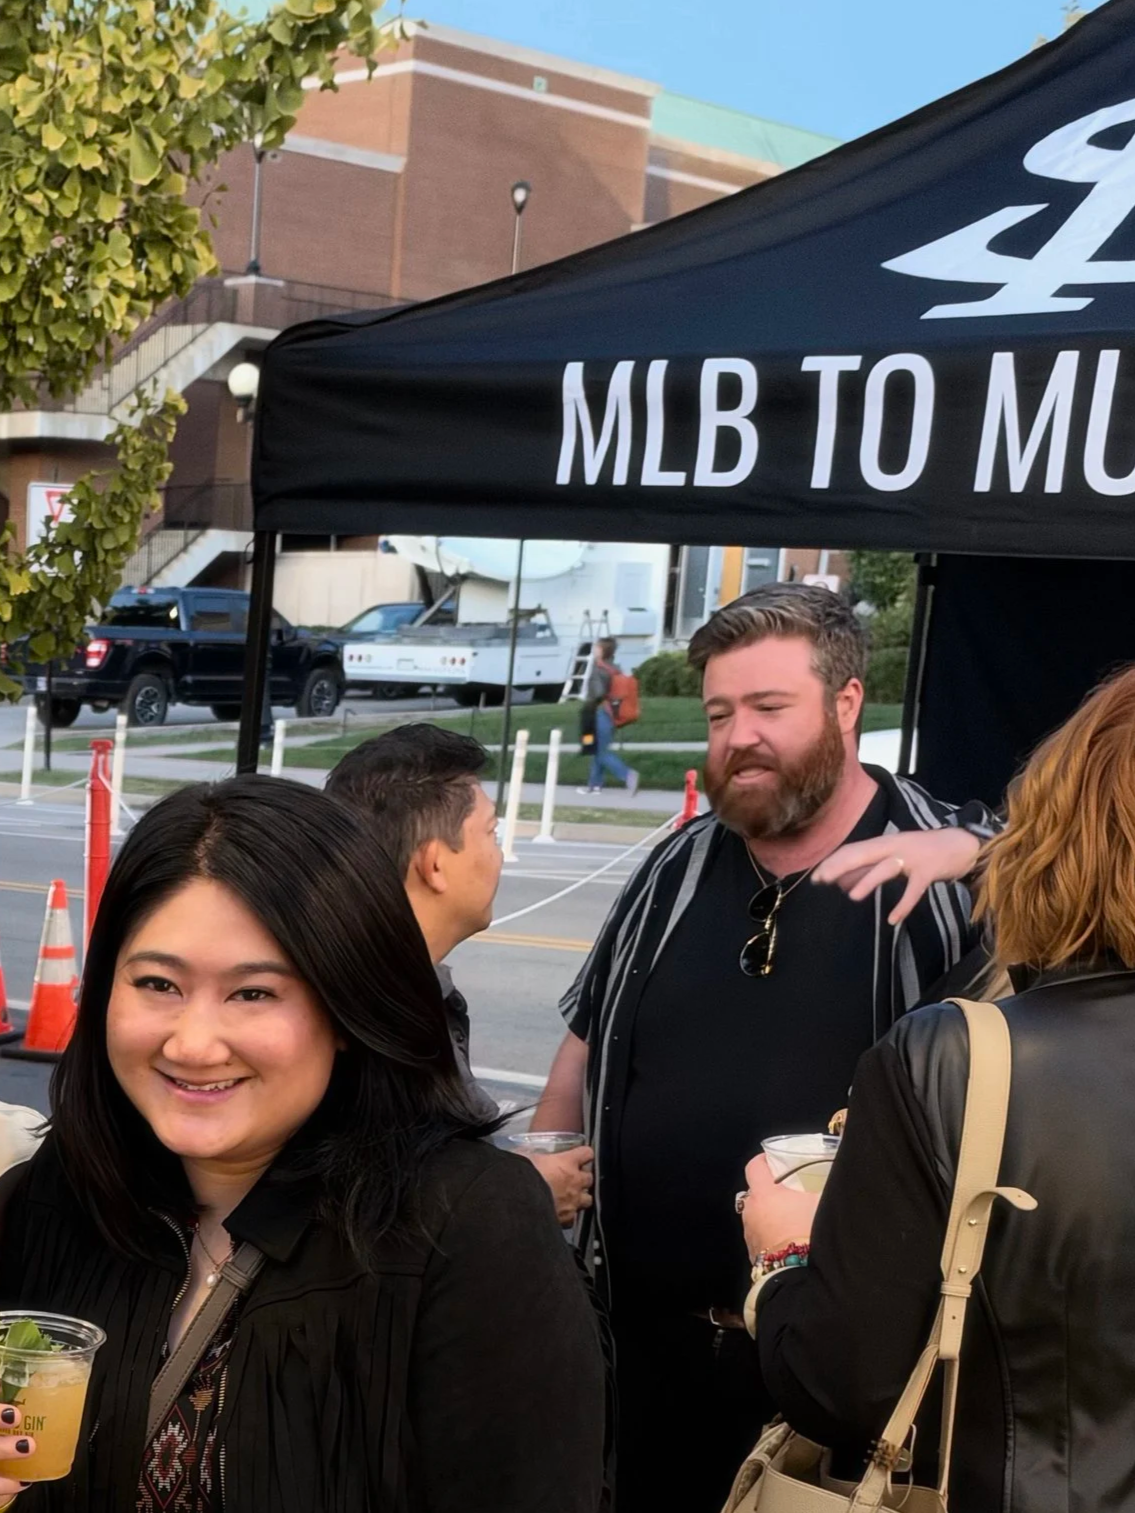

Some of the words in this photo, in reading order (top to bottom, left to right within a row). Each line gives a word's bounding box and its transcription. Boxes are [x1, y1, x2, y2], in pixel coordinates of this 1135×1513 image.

[555, 357, 759, 487] MLB
[800, 352, 935, 492] TO
[23, 1415, 45, 1431] GIN
